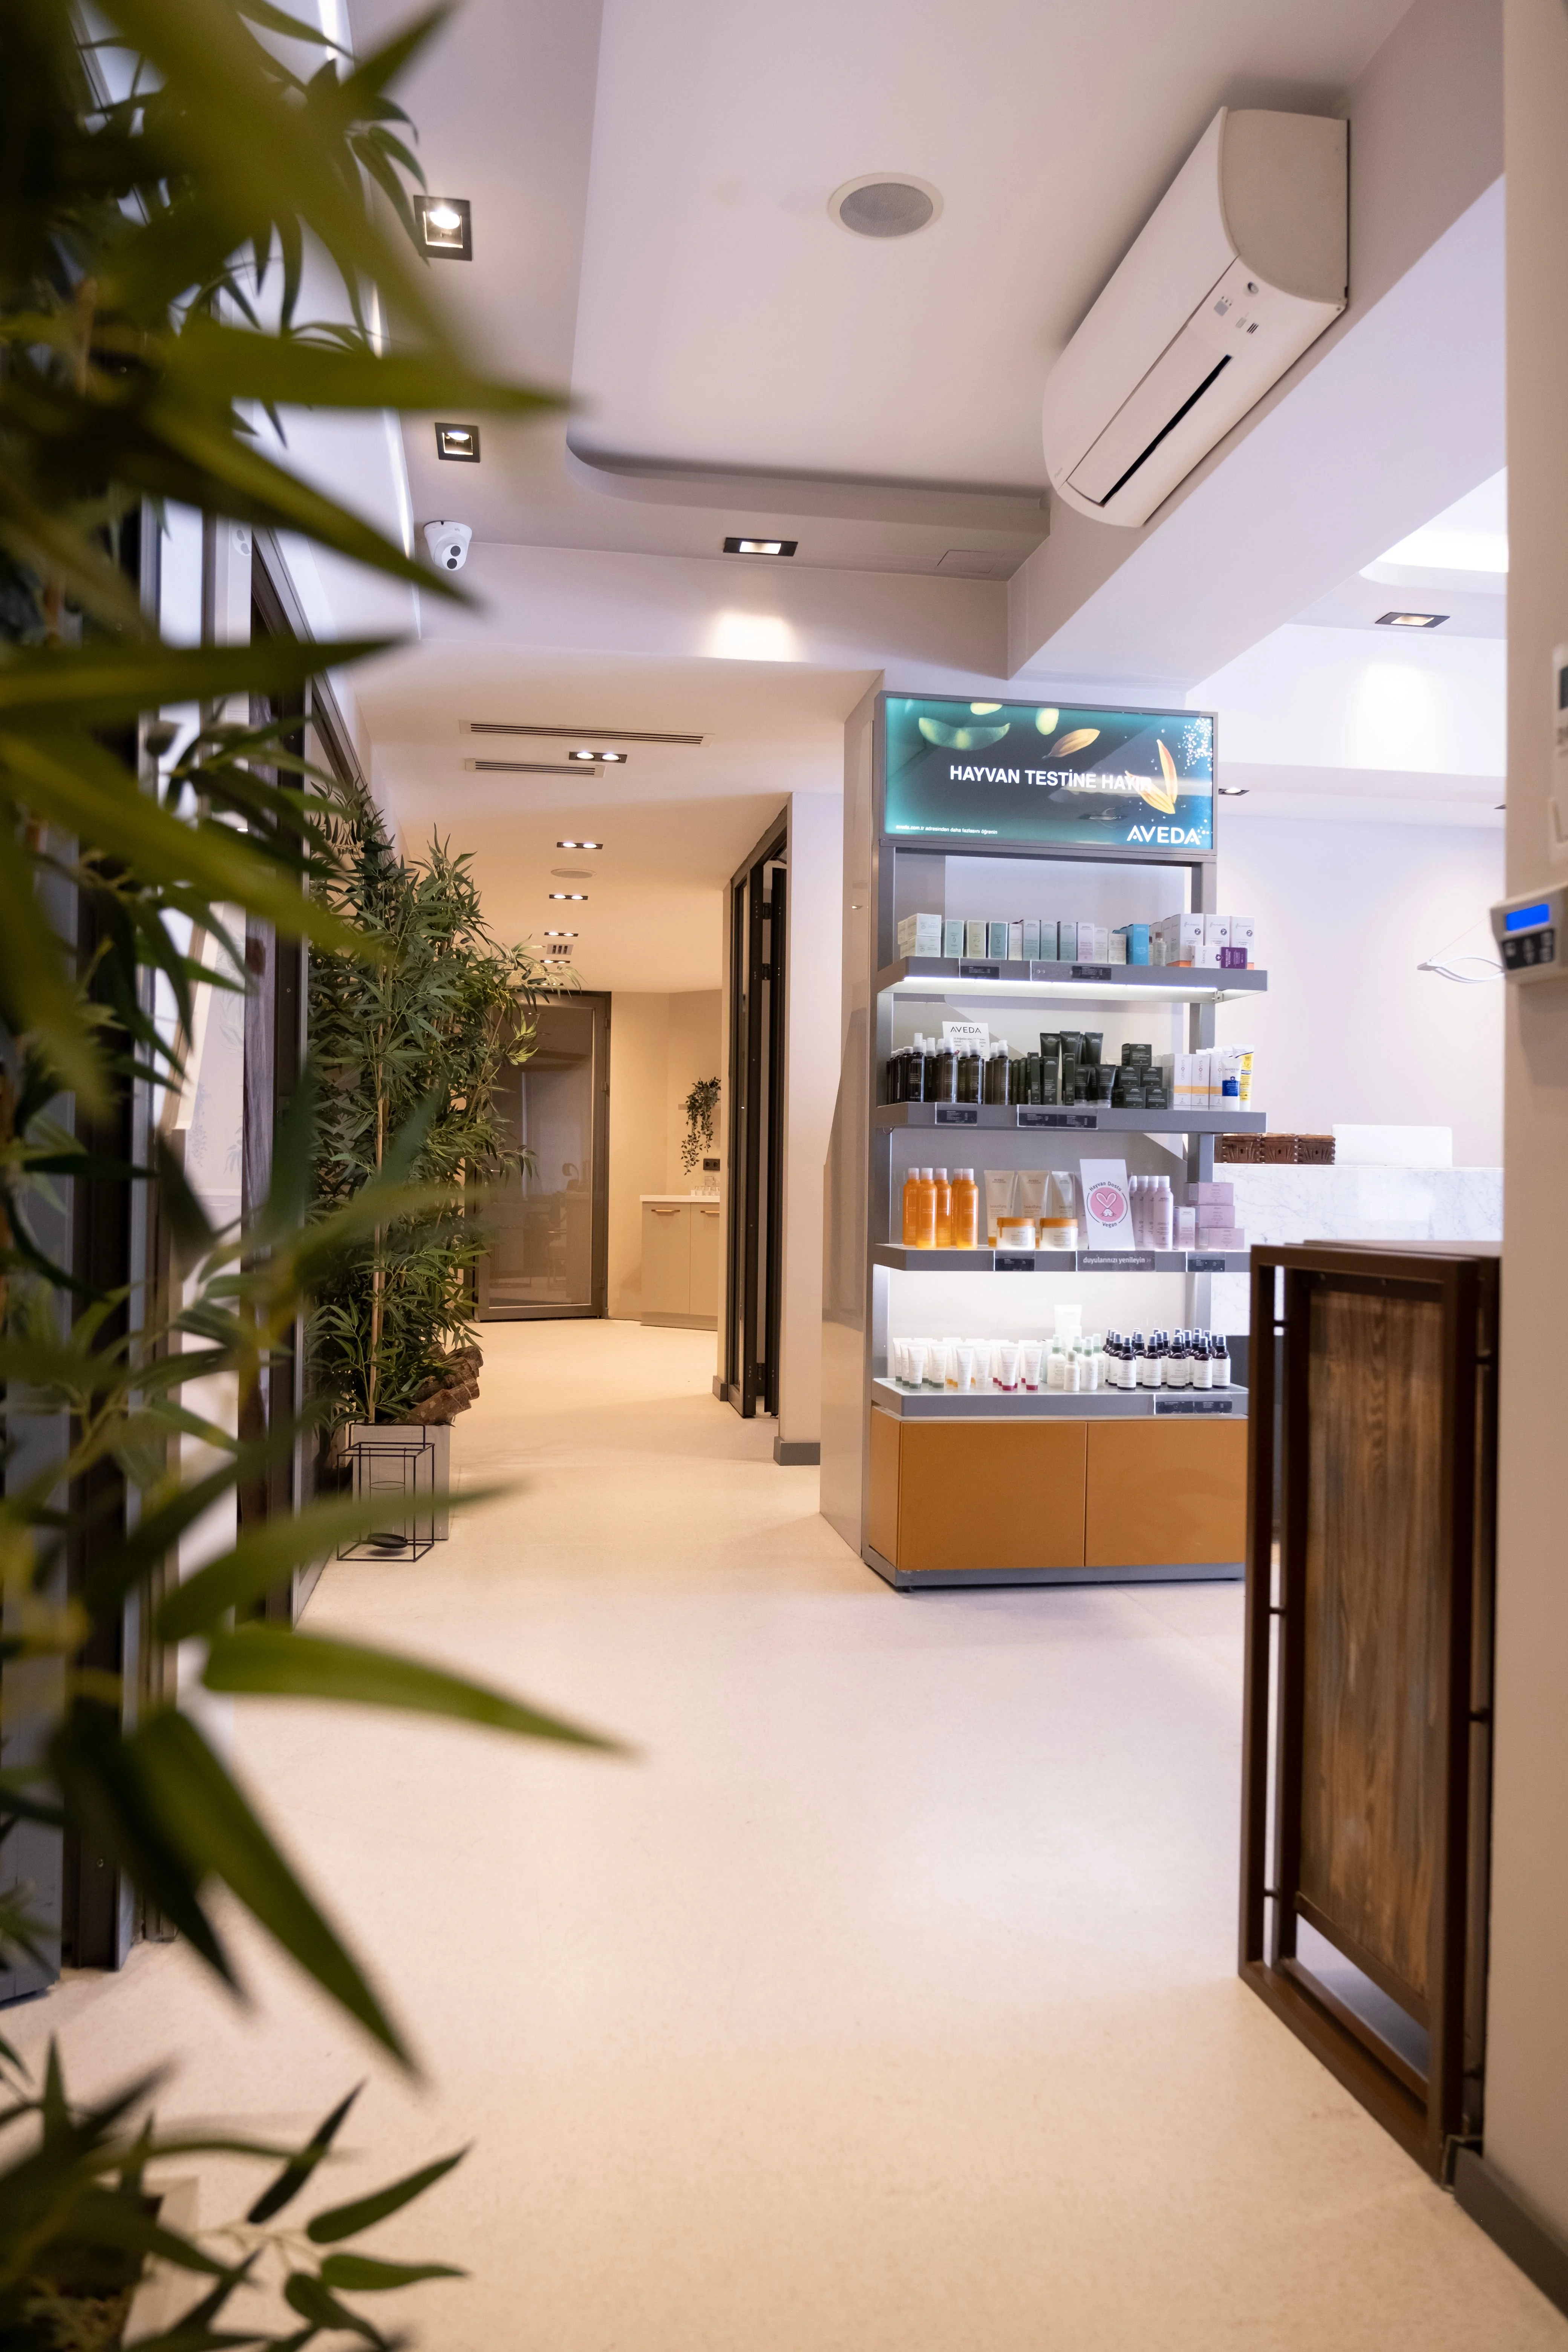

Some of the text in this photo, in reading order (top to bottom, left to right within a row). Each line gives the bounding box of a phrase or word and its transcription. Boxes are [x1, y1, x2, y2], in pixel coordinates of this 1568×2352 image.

[949, 765, 1152, 791] HAYVAN TESTİNE HAYIR
[1126, 825, 1200, 845] AVEDA
[1089, 1181, 1122, 1191] Hayvan Dostu
